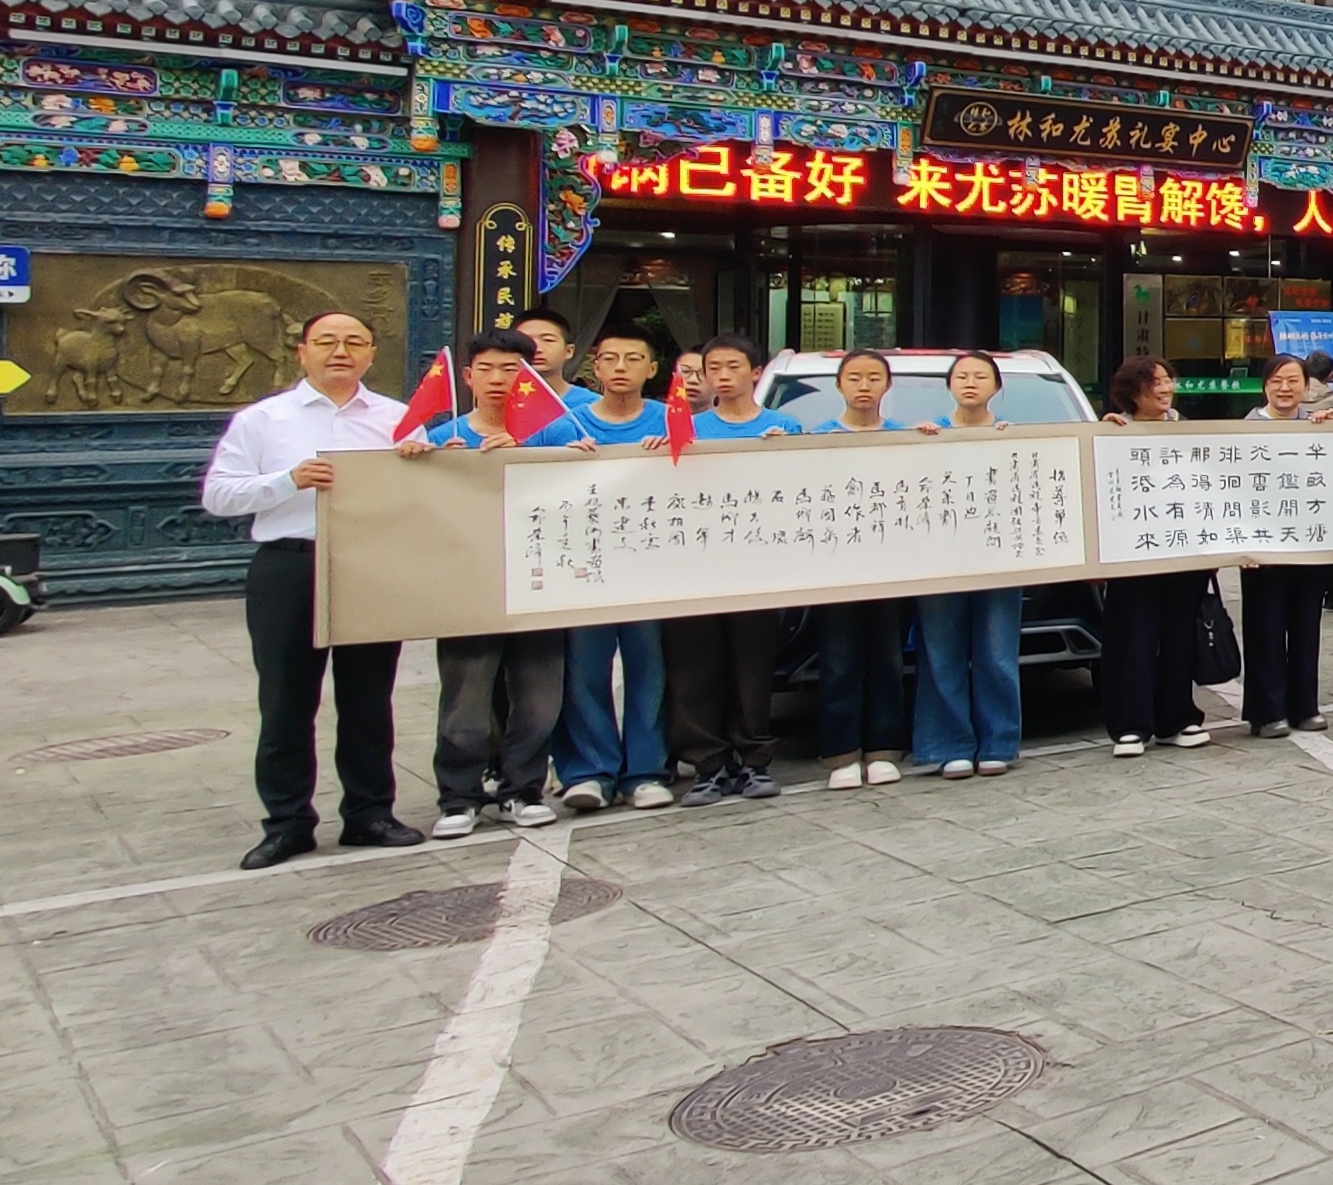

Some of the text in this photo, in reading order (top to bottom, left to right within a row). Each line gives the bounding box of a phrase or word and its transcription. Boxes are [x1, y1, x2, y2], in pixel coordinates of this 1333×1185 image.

[1007, 110, 1236, 155] 林和尤苏礼宴中心
